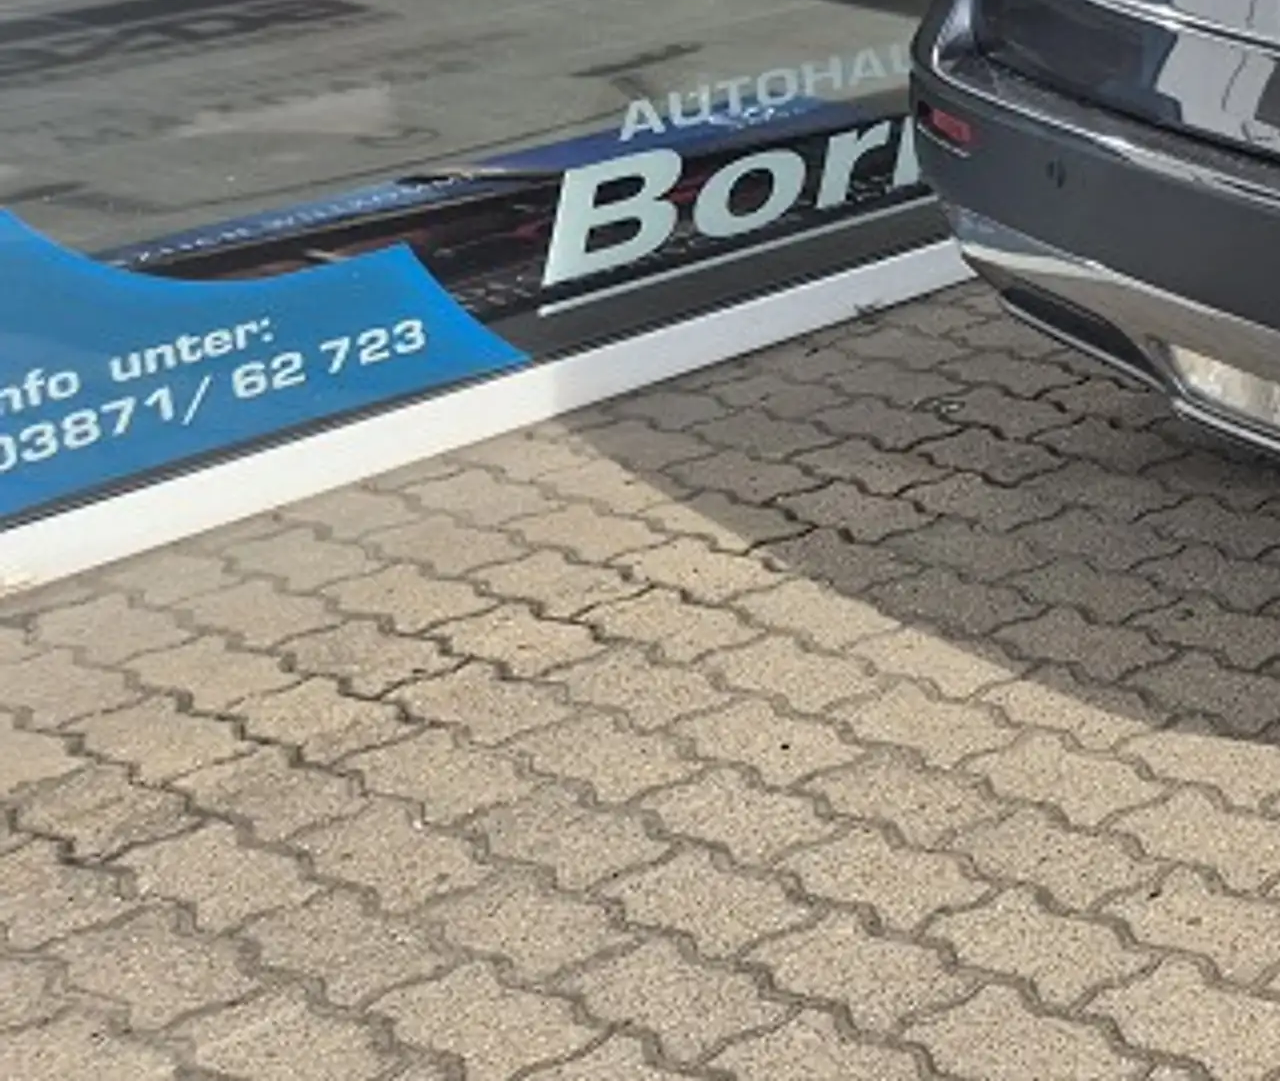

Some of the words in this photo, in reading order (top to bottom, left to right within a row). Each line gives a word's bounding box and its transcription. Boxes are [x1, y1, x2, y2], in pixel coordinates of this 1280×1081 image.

[108, 316, 275, 383] unter:
[232, 351, 306, 400] 62
[320, 318, 428, 375] 723
